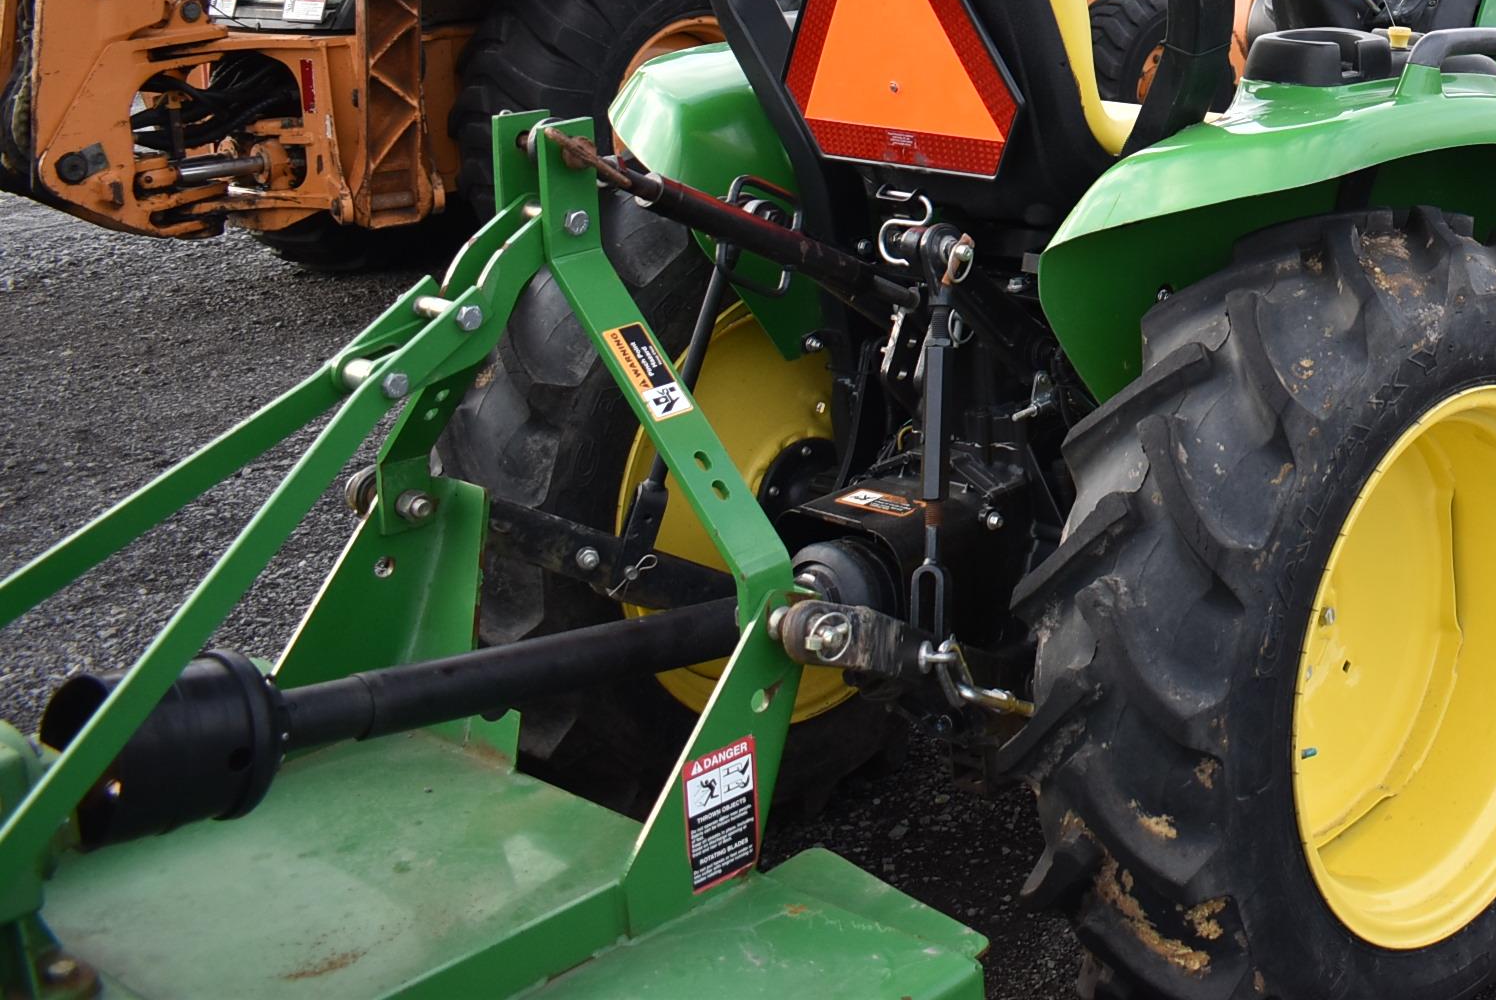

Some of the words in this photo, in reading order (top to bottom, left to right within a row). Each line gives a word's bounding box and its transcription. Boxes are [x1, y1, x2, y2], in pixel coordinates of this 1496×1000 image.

[610, 332, 641, 378] WARNING
[630, 341, 643, 359] Point
[640, 346, 658, 368] Hazard
[640, 358, 655, 377] Pinch
[703, 741, 748, 769] DANGER
[697, 808, 721, 825] THROWN
[721, 796, 747, 813] OBJECTS
[699, 847, 727, 865] ROTATING
